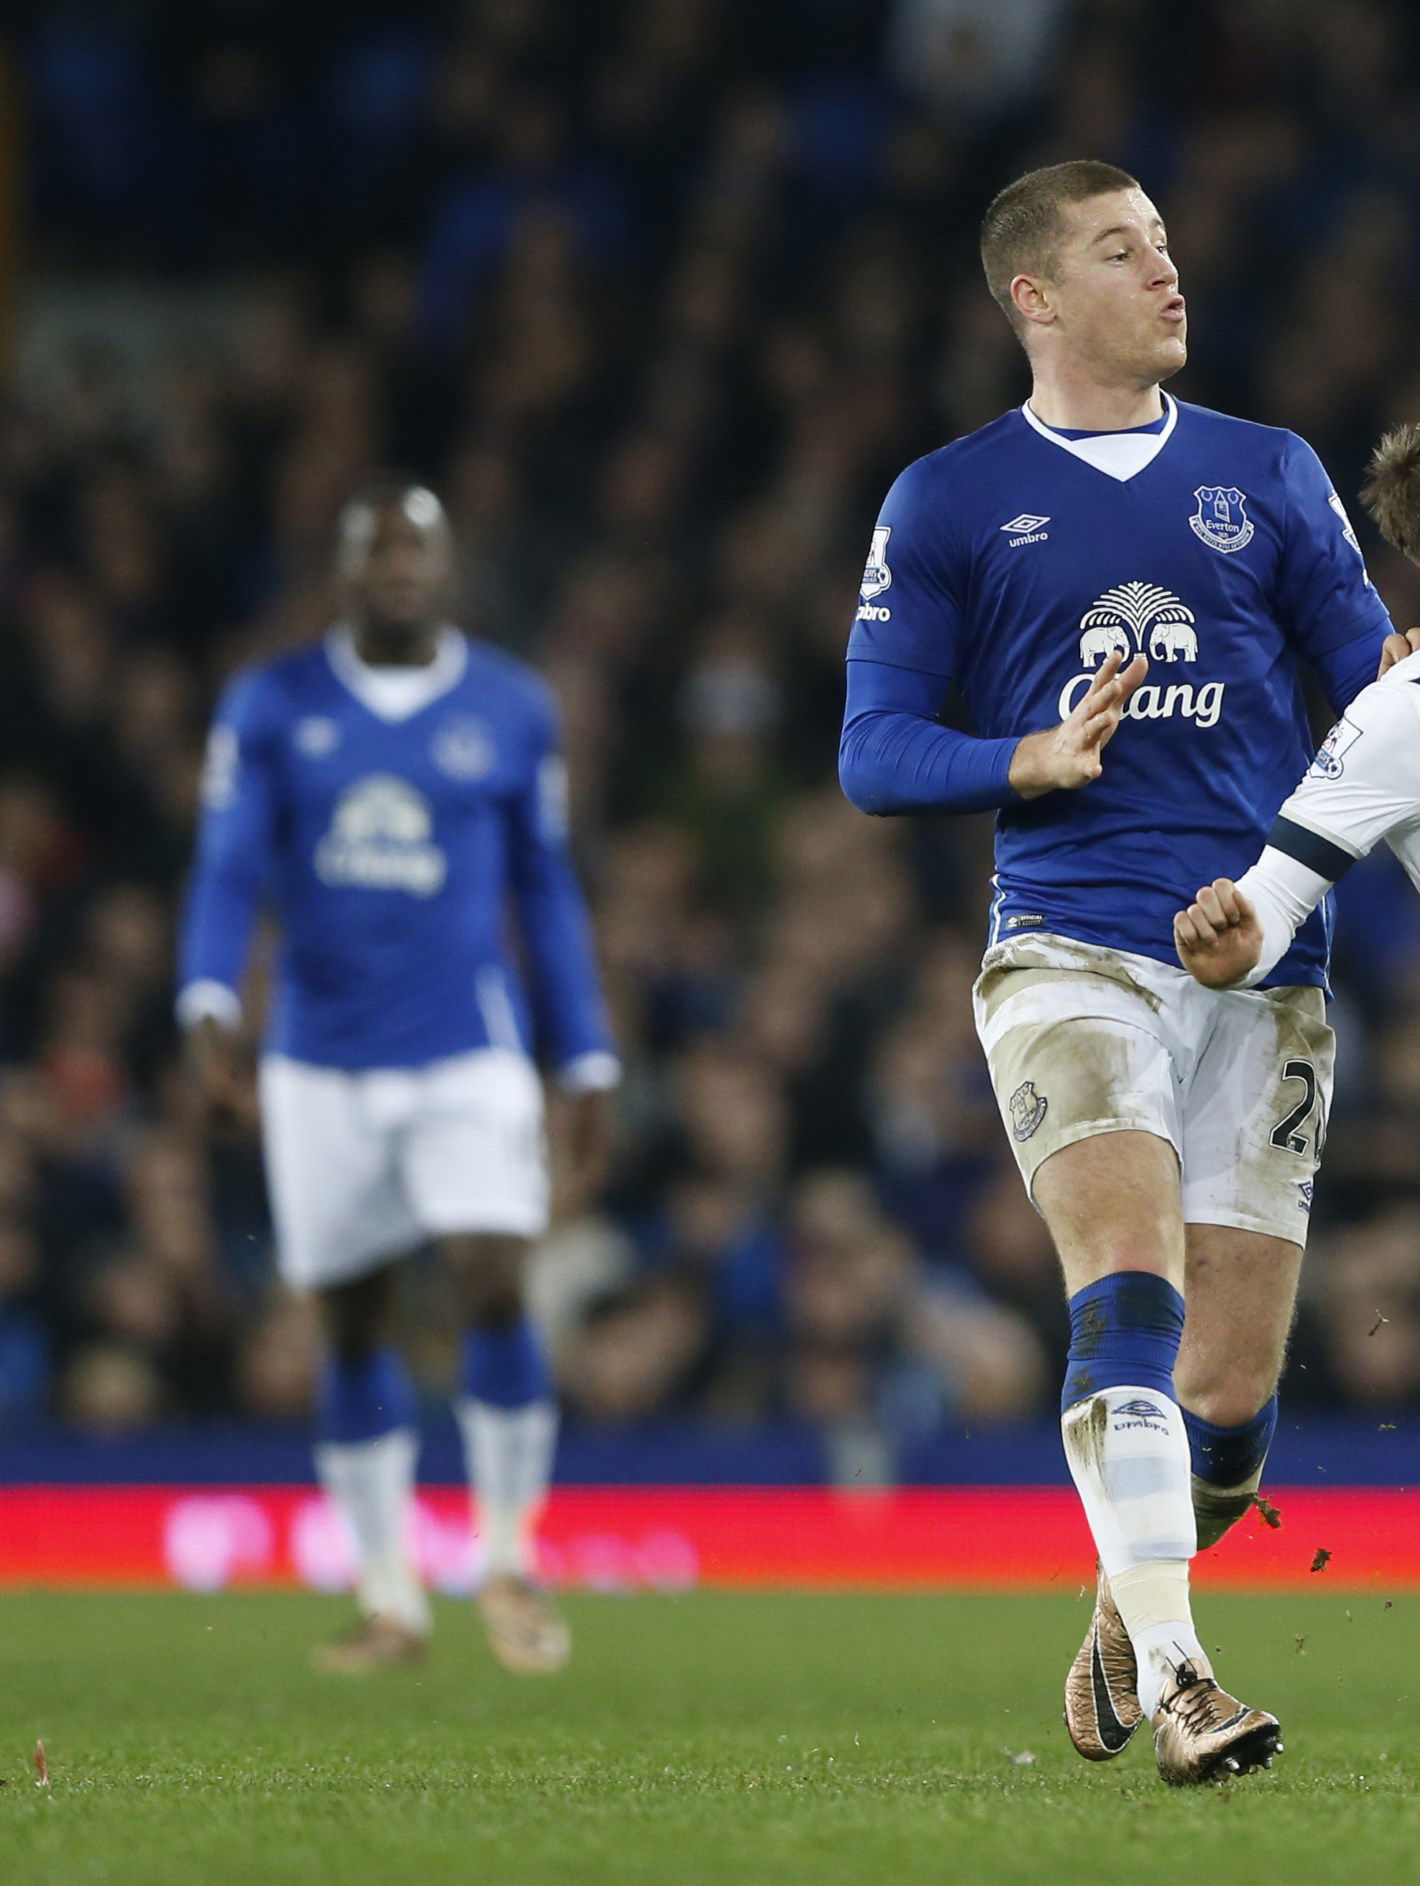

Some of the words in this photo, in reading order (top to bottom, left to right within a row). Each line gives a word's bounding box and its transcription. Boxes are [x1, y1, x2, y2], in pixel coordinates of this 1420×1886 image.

[1205, 519, 1240, 533] Everton
[1008, 532, 1049, 548] umbro
[856, 602, 891, 622] bro
[1058, 673, 1226, 729] Cang
[1113, 1417, 1170, 1436] umbro
